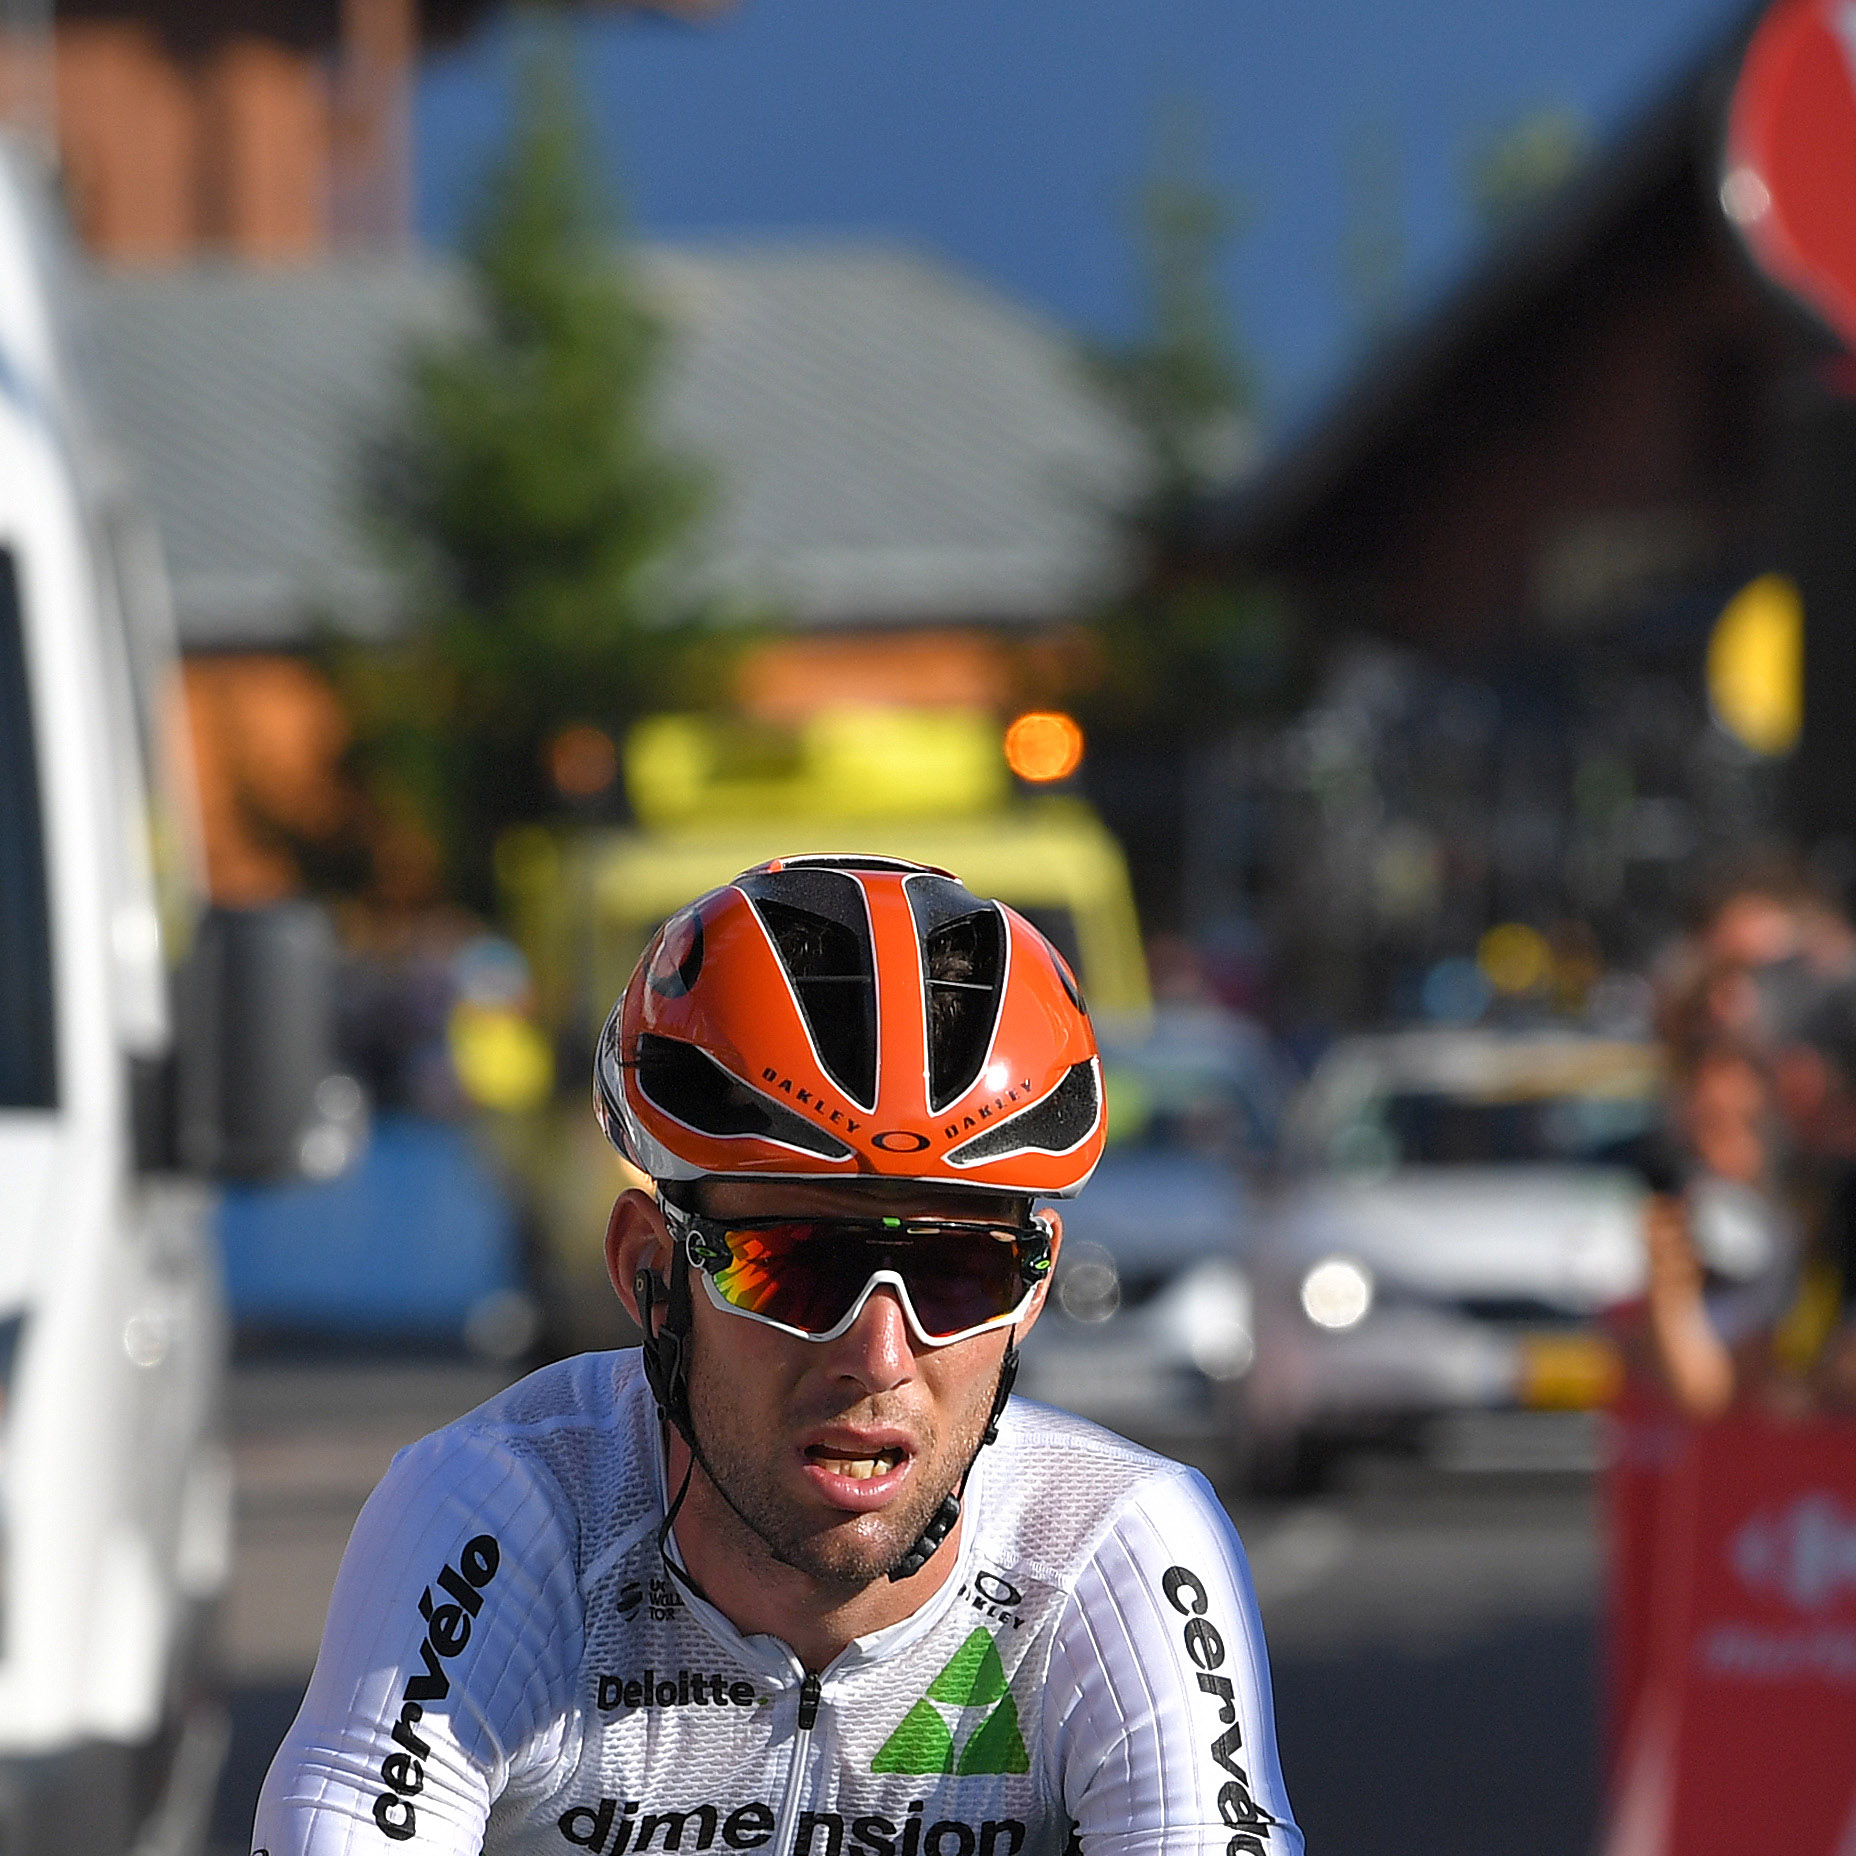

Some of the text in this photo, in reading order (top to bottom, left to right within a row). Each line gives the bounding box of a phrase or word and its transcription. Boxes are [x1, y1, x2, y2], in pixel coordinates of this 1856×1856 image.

[762, 1066, 861, 1134] OAKLEY
[944, 1077, 1032, 1140] OAKLEY
[957, 1584, 1025, 1630] KLEY
[372, 1532, 502, 1843] cervélo
